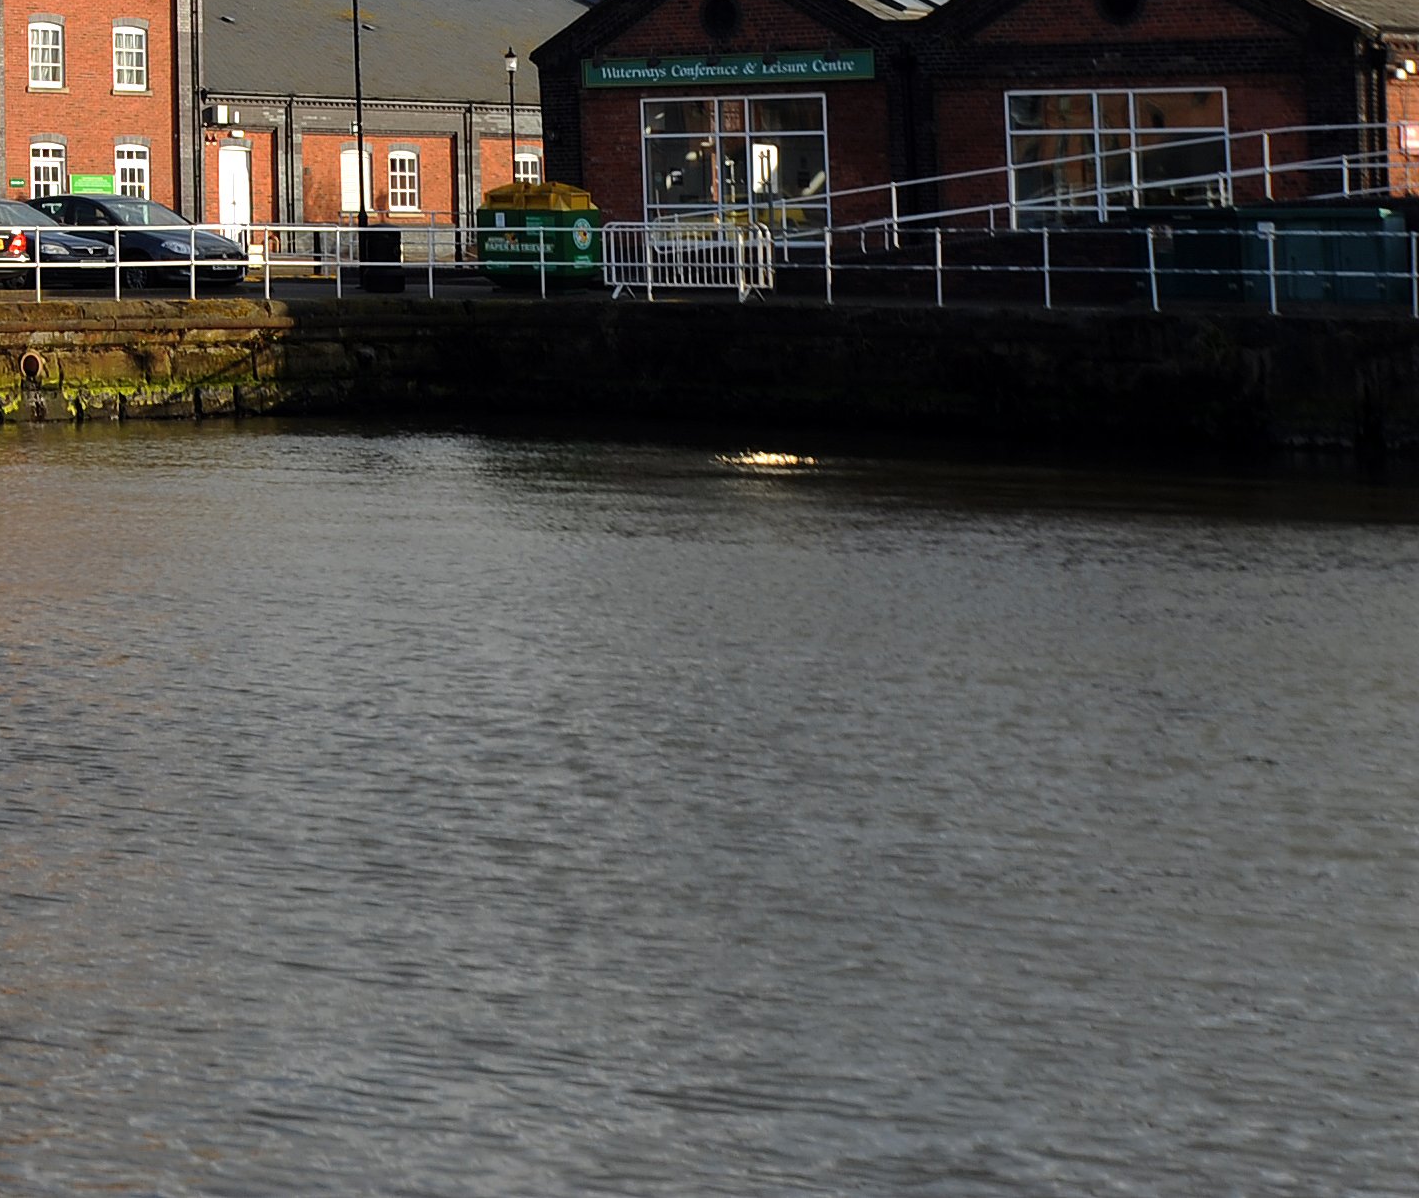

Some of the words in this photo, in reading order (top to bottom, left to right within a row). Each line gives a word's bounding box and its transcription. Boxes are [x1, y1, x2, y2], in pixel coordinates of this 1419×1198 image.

[601, 66, 667, 82] Waterways
[671, 62, 739, 81] Conference
[743, 62, 757, 75] &
[763, 61, 808, 74] Leisure
[812, 59, 855, 73] Centre
